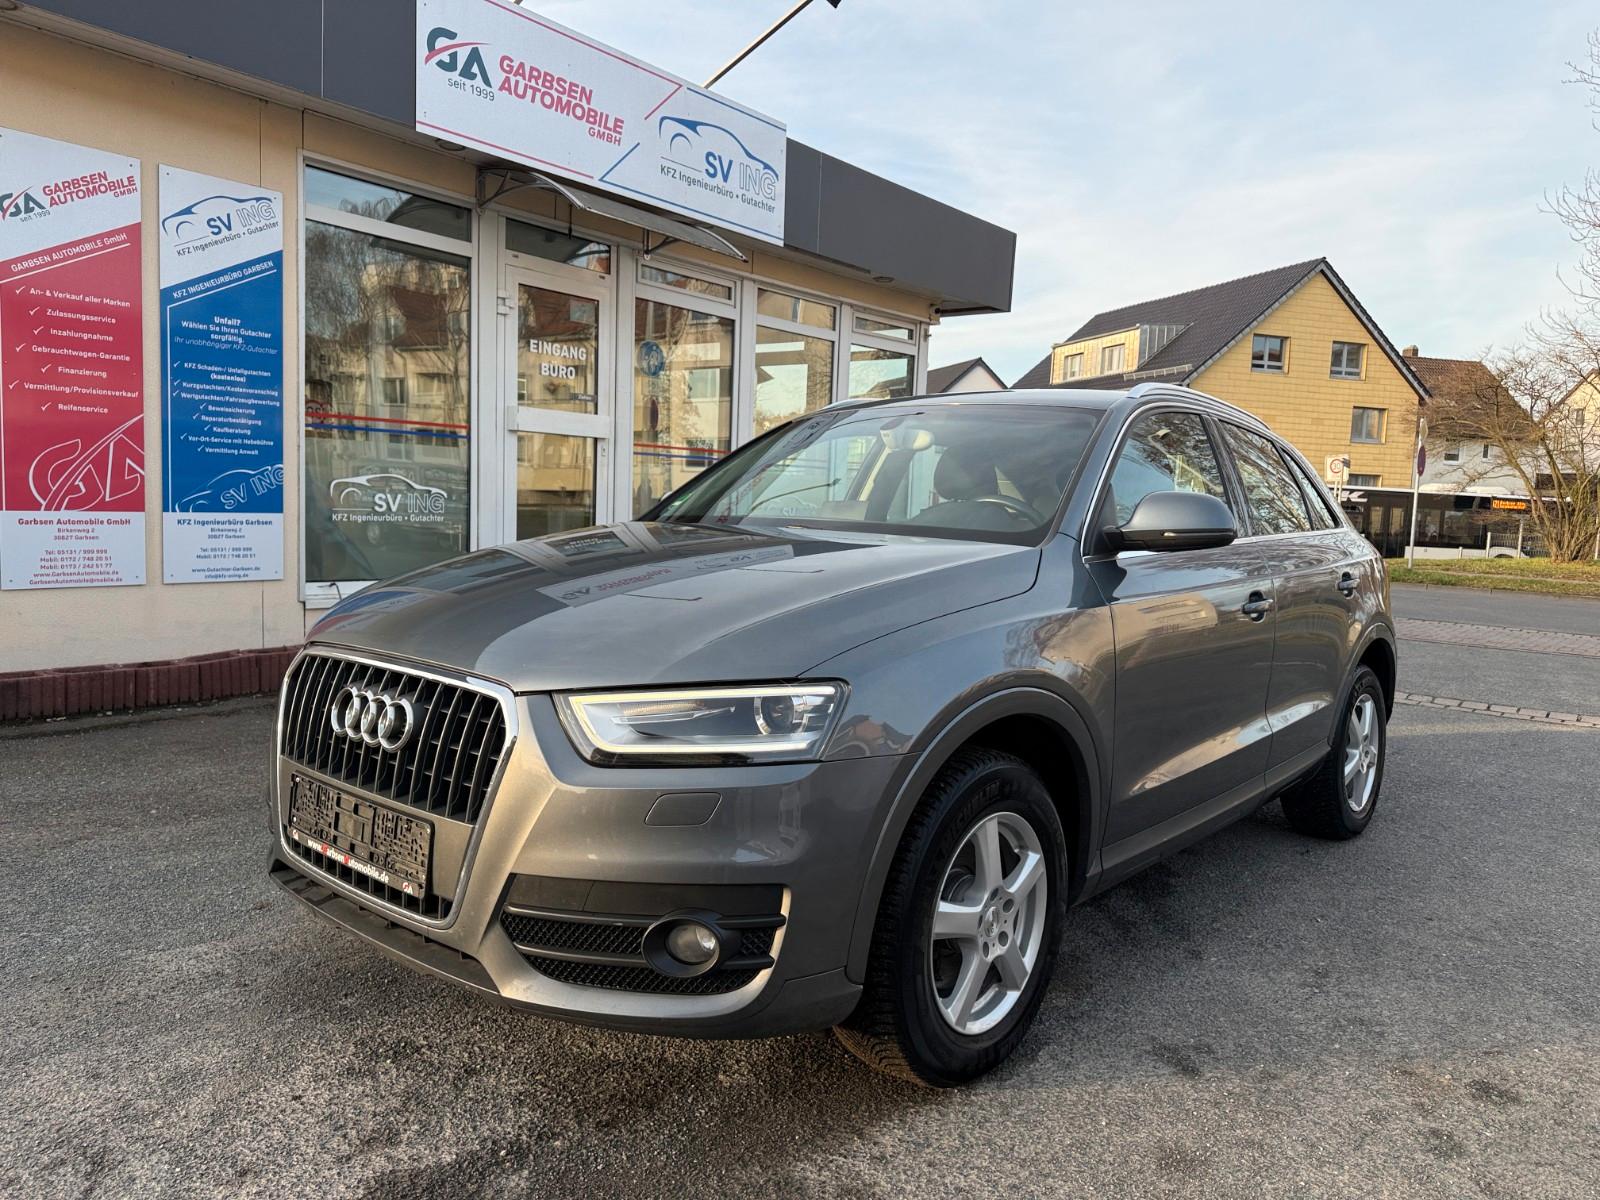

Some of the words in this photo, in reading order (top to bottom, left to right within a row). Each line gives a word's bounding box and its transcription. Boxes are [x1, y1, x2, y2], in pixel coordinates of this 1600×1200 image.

[447, 78, 466, 92] seit
[470, 84, 495, 101] 1999
[499, 55, 593, 105] GARBSEN
[498, 75, 624, 136] AUTOMOBILE
[588, 126, 621, 146] GMBH
[42, 171, 108, 196] GARBSEN
[705, 151, 733, 183] SV
[739, 162, 776, 201] ING
[49, 176, 136, 208] AUTOMOBILE
[114, 187, 138, 198] GMBH
[660, 164, 677, 179] KFZ
[679, 171, 734, 200] Ingenieurbüro
[741, 193, 775, 214] Gutachter
[20, 214, 33, 222] seit
[34, 210, 51, 219] 1999
[206, 213, 232, 236] SV
[236, 201, 277, 228] ING
[176, 246, 192, 256] KFZ
[192, 232, 241, 252] Ingenieurbüro
[247, 221, 279, 235] Gutachter
[11, 255, 51, 272] GARBSEN
[52, 239, 103, 260] AUTOMOBILE
[104, 232, 127, 245] GmbH
[172, 289, 188, 299] KFZ
[188, 271, 242, 294] INGENIEURBÜRO
[243, 260, 274, 275] GARBSEN
[29, 287, 44, 295] An-
[45, 289, 52, 297] &
[53, 290, 83, 301] Verkauf
[103, 298, 131, 308] Marken
[46, 308, 116, 324] Zulassungsservice
[214, 316, 241, 326] Unfall?
[50, 328, 113, 342] Inzahlungnahme
[181, 320, 208, 330] Wählen
[209, 324, 220, 332] Sie
[221, 326, 238, 334] Ihren
[240, 328, 272, 339] Gutachter
[32, 345, 131, 361] Gebrauchtwagen-Garantie
[529, 339, 587, 361] EINGANG
[58, 366, 107, 378] Finanzierung
[541, 360, 576, 380] BÜRO
[58, 403, 109, 414] Reifenservice
[220, 483, 248, 509] SV
[374, 493, 401, 512] SV
[408, 493, 444, 513] ING
[18, 518, 54, 526] Garbsen
[56, 518, 104, 526] Automobile
[107, 518, 131, 526] GmbH
[193, 518, 243, 527] Ingenieurbüro
[332, 513, 348, 521] KFZ
[350, 513, 402, 523] Ingenieurbüro
[410, 513, 444, 522] Gutachter
